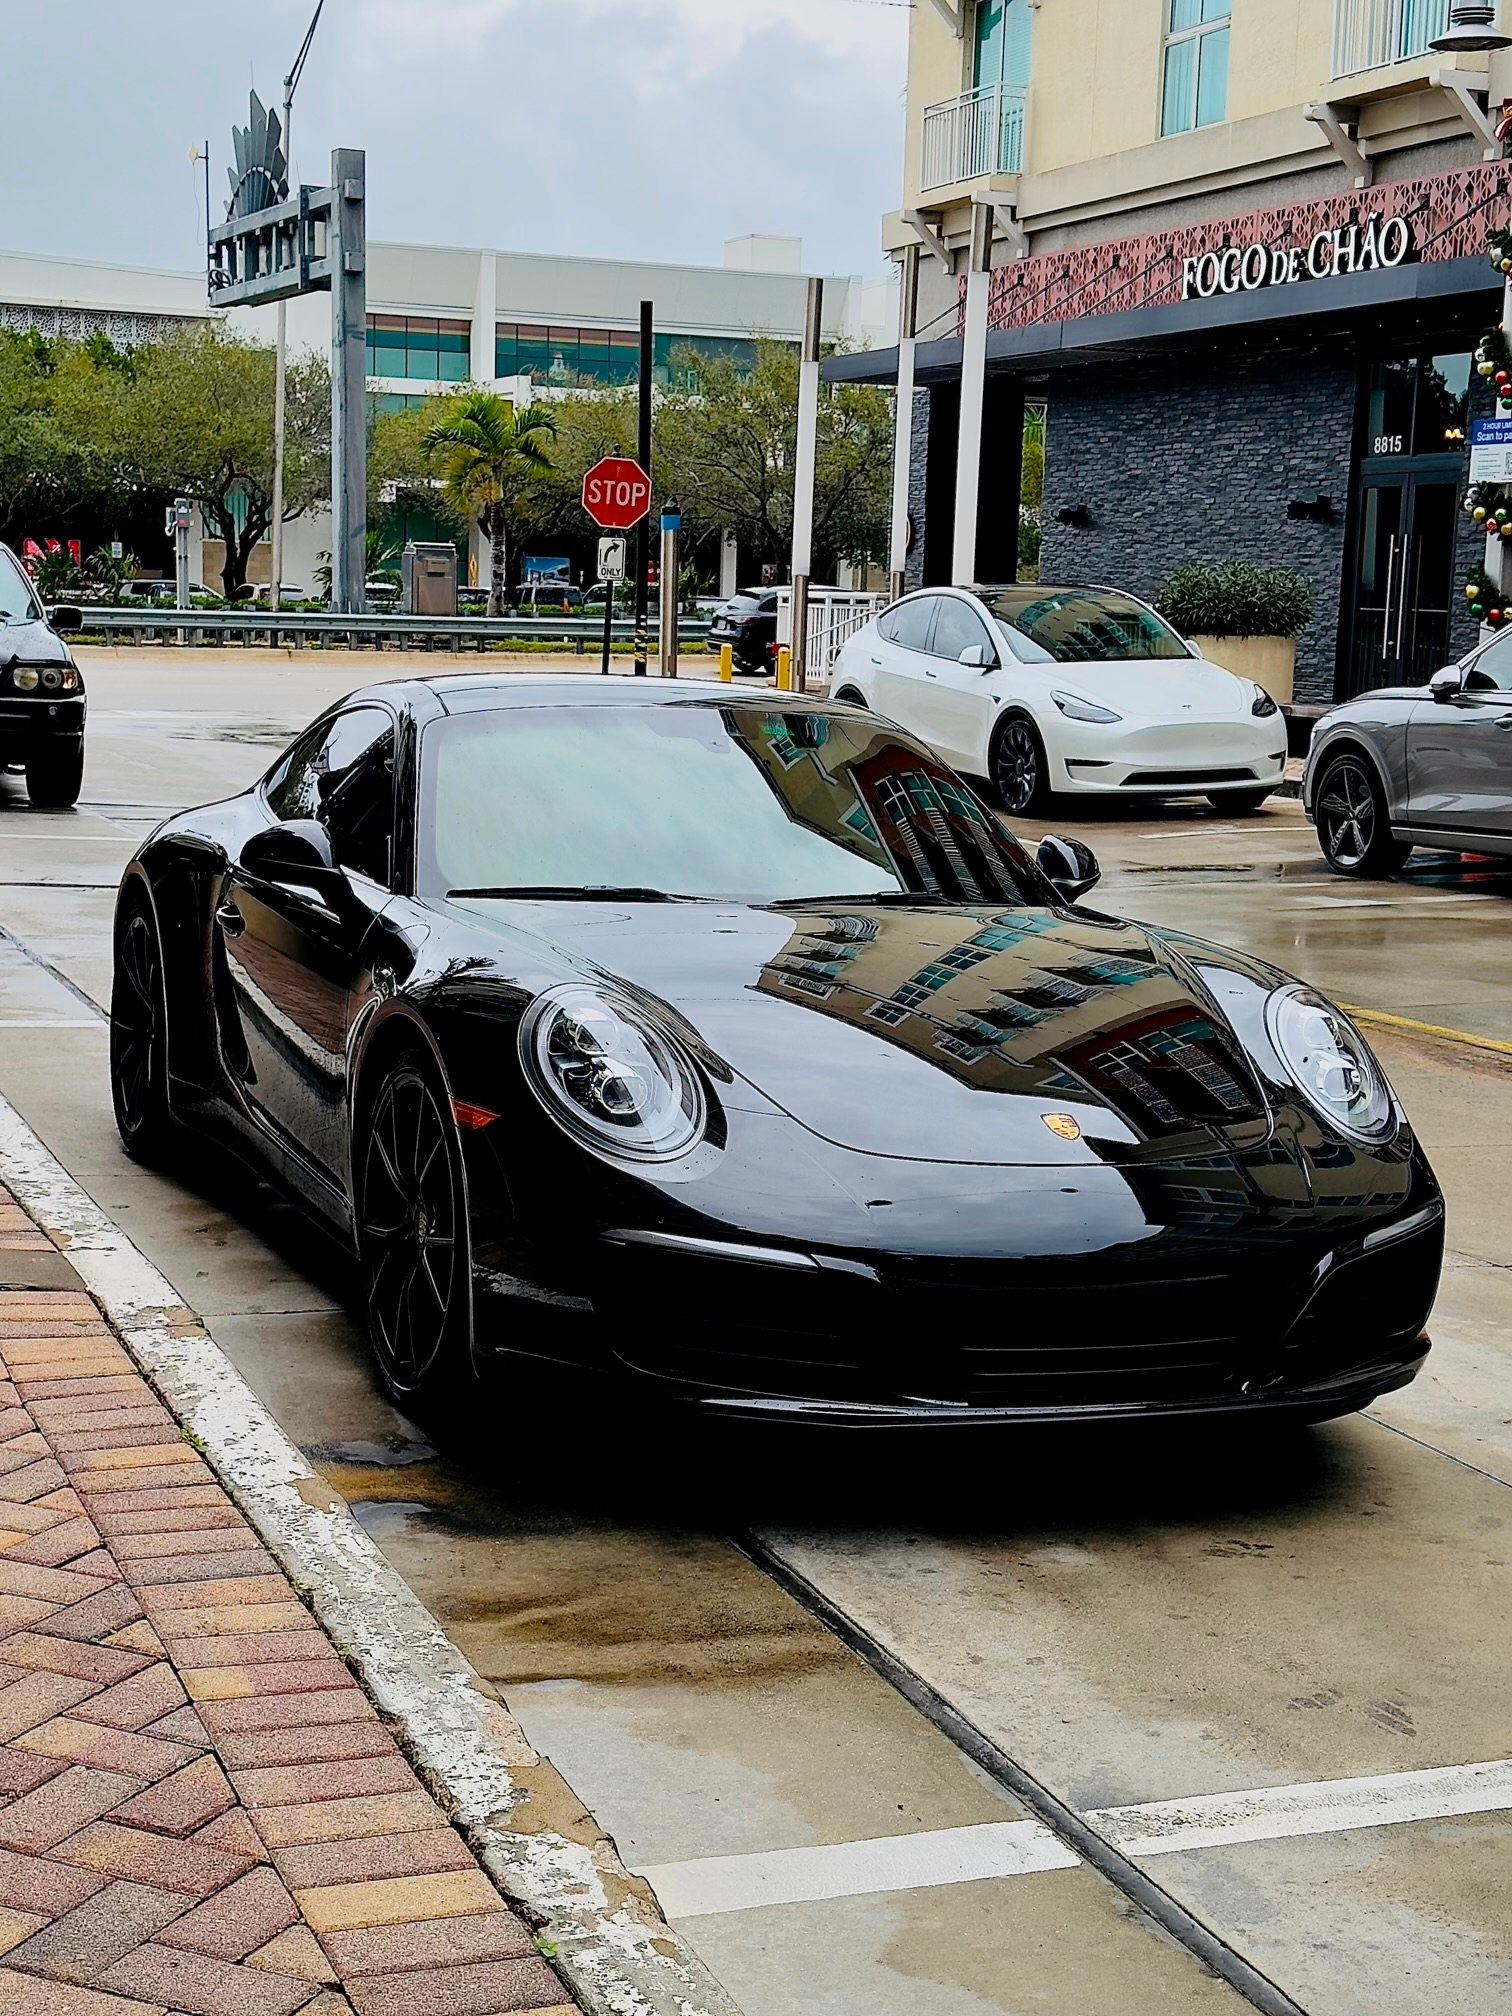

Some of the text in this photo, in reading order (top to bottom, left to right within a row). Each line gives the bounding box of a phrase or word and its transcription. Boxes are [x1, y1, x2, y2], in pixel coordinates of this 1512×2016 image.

[1181, 211, 1409, 300] FOGO DE CHÃO
[1374, 435, 1402, 454] 8815
[1477, 432, 1494, 441] Scan
[1495, 431, 1503, 440] to
[588, 479, 646, 507] STOP
[600, 567, 621, 577] ONLY
